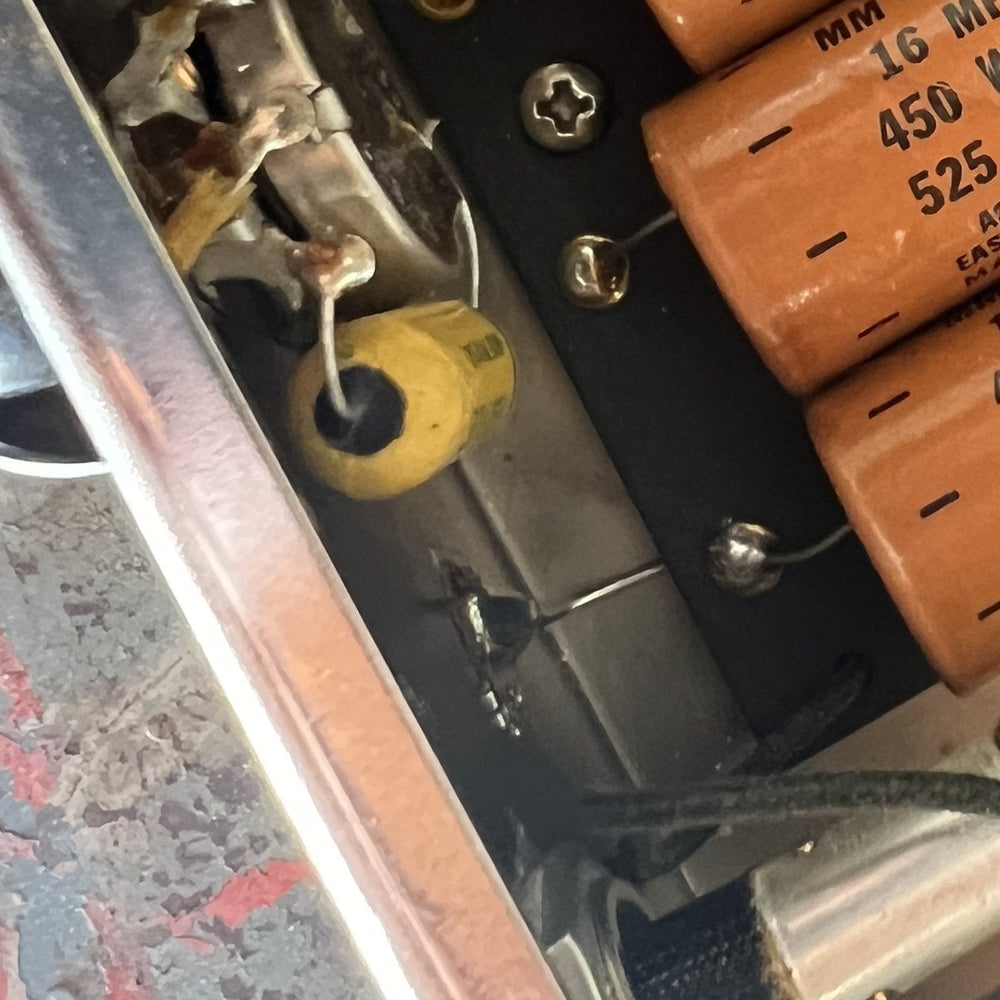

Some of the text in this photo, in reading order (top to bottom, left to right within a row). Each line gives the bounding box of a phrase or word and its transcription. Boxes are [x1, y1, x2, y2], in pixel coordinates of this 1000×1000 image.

[869, 25, 930, 81] 16
[878, 80, 963, 152] 450
[907, 139, 998, 216] 525
